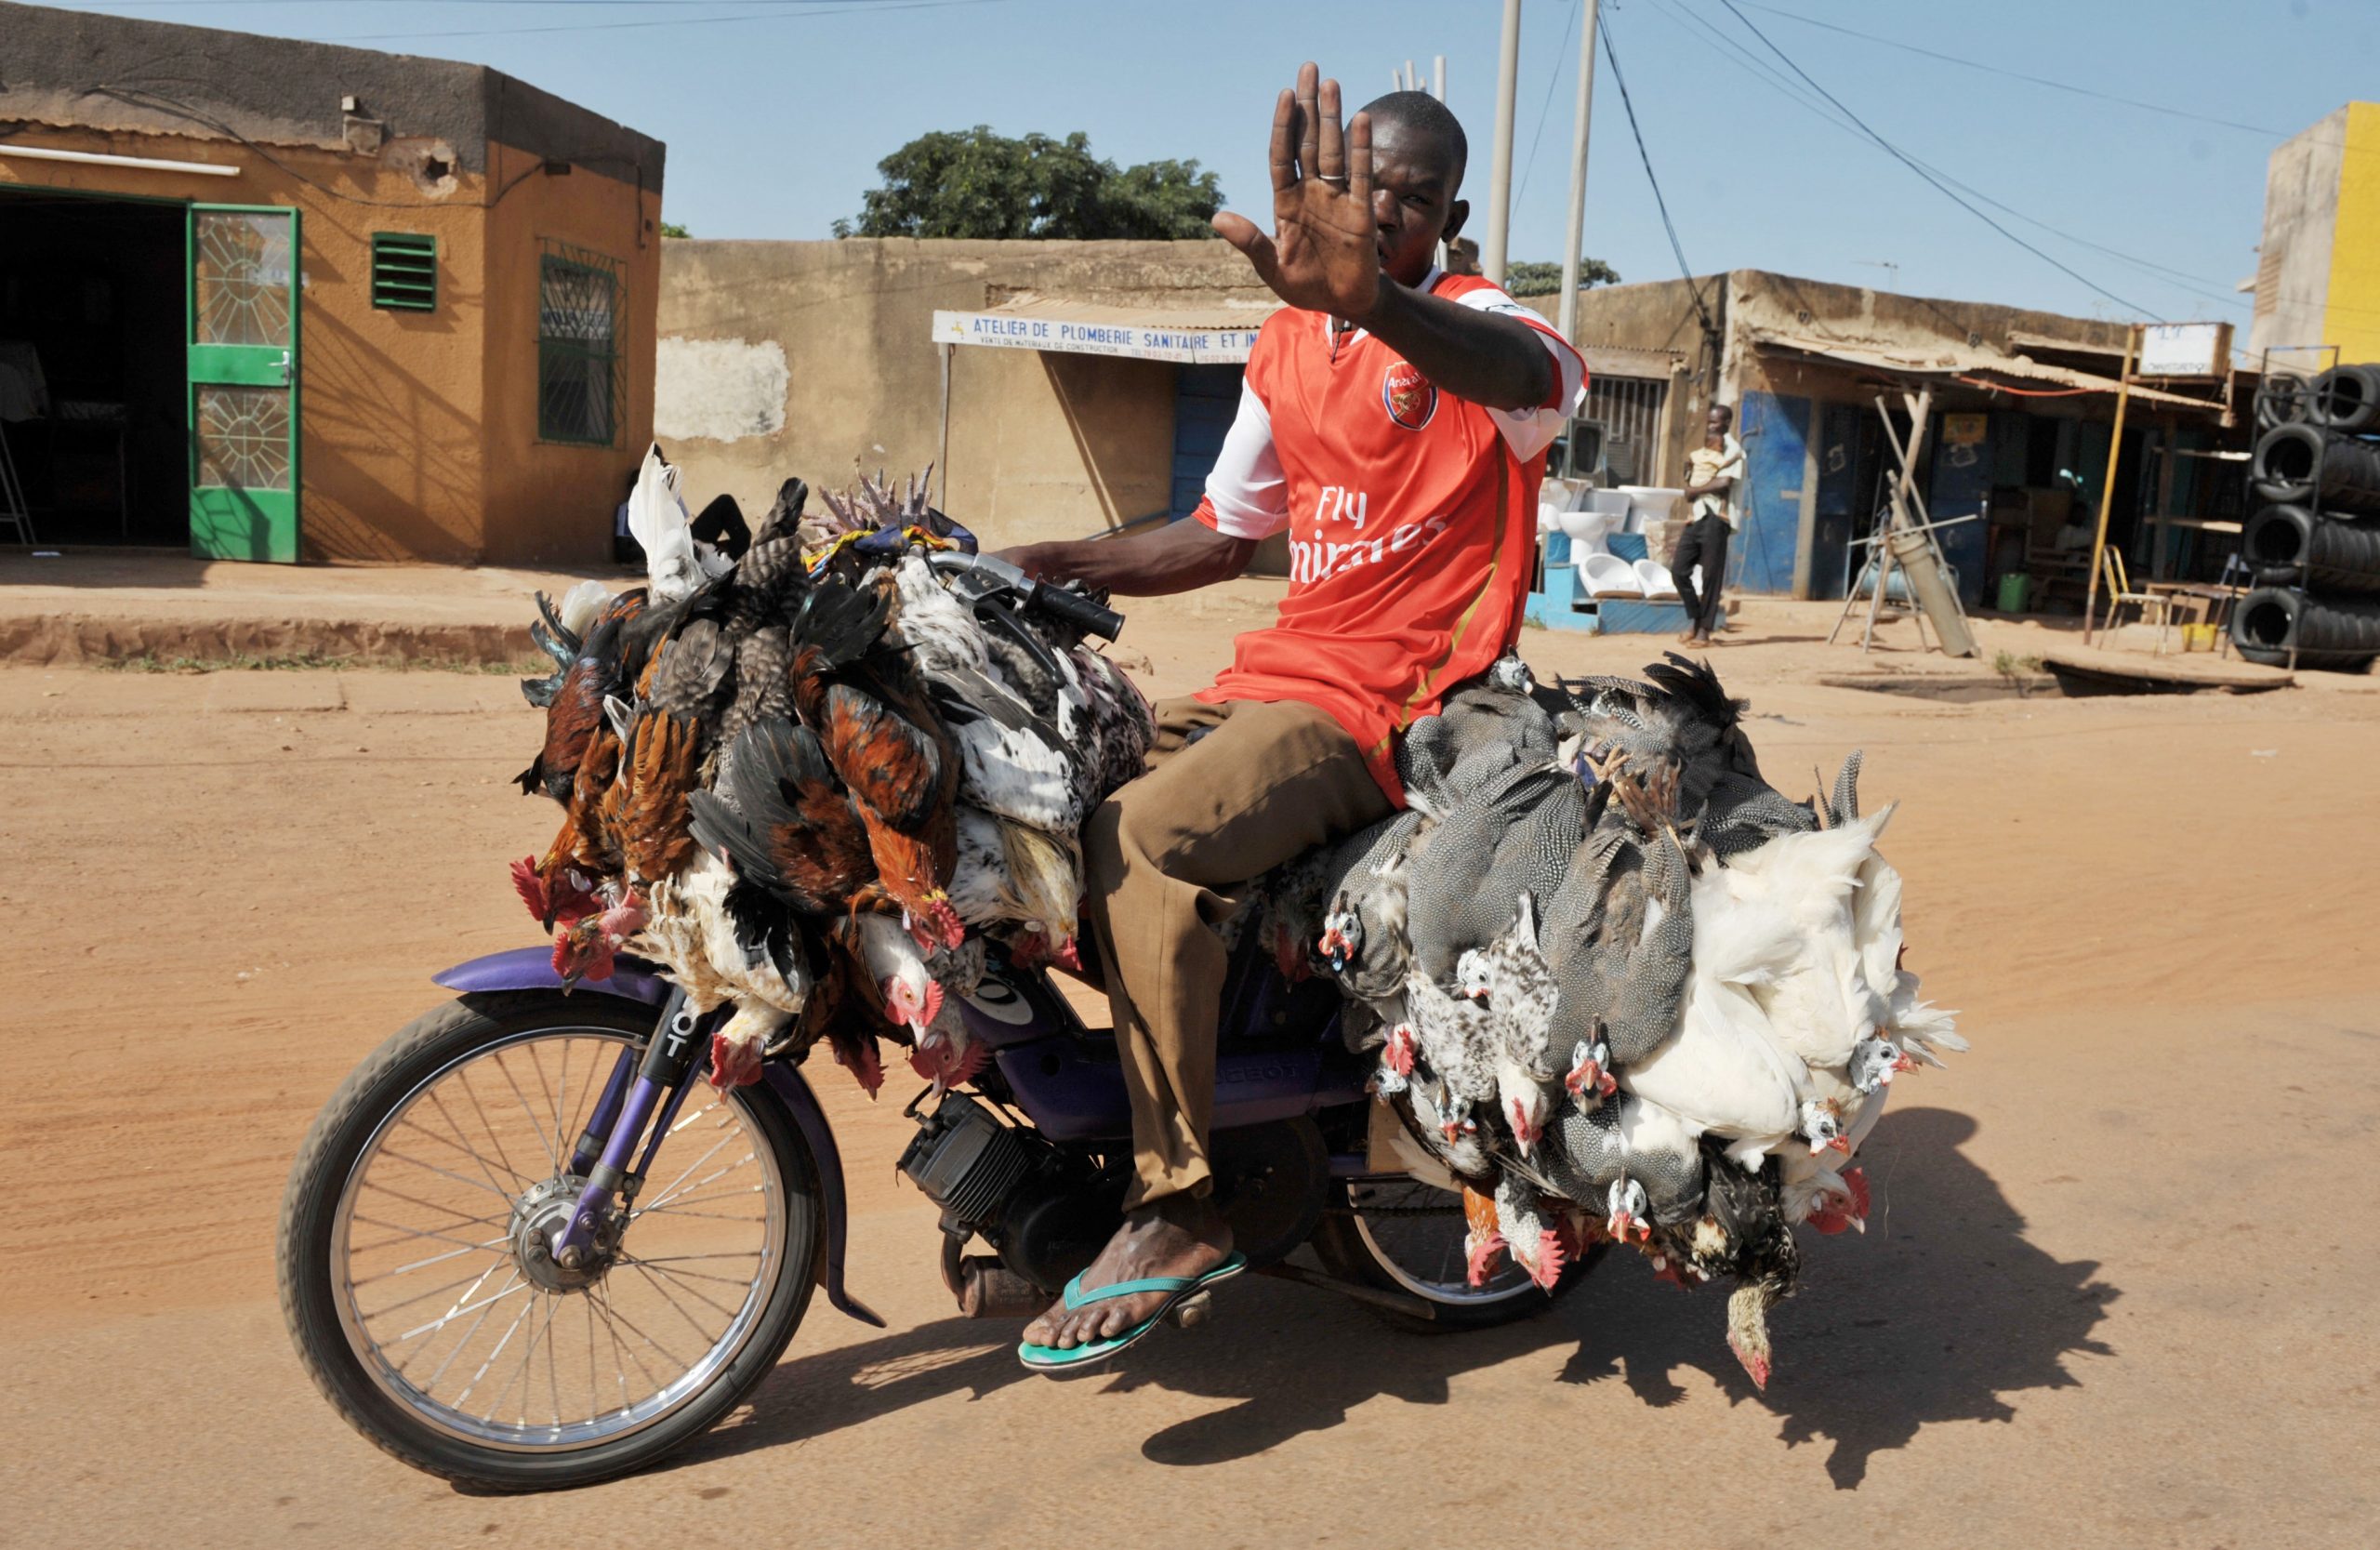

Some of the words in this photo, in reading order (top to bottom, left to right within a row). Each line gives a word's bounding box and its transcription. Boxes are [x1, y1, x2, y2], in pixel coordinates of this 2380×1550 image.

[974, 319, 1027, 336] ATELIER
[1033, 322, 1050, 338] DE
[1061, 325, 1132, 346] PLOMBERIE
[1144, 333, 1209, 350] SANITAIRE
[1221, 333, 1237, 349] ET
[1054, 342, 1064, 351] DE
[1066, 343, 1118, 353] CONSTRUCTION
[1315, 485, 1368, 530] Fly
